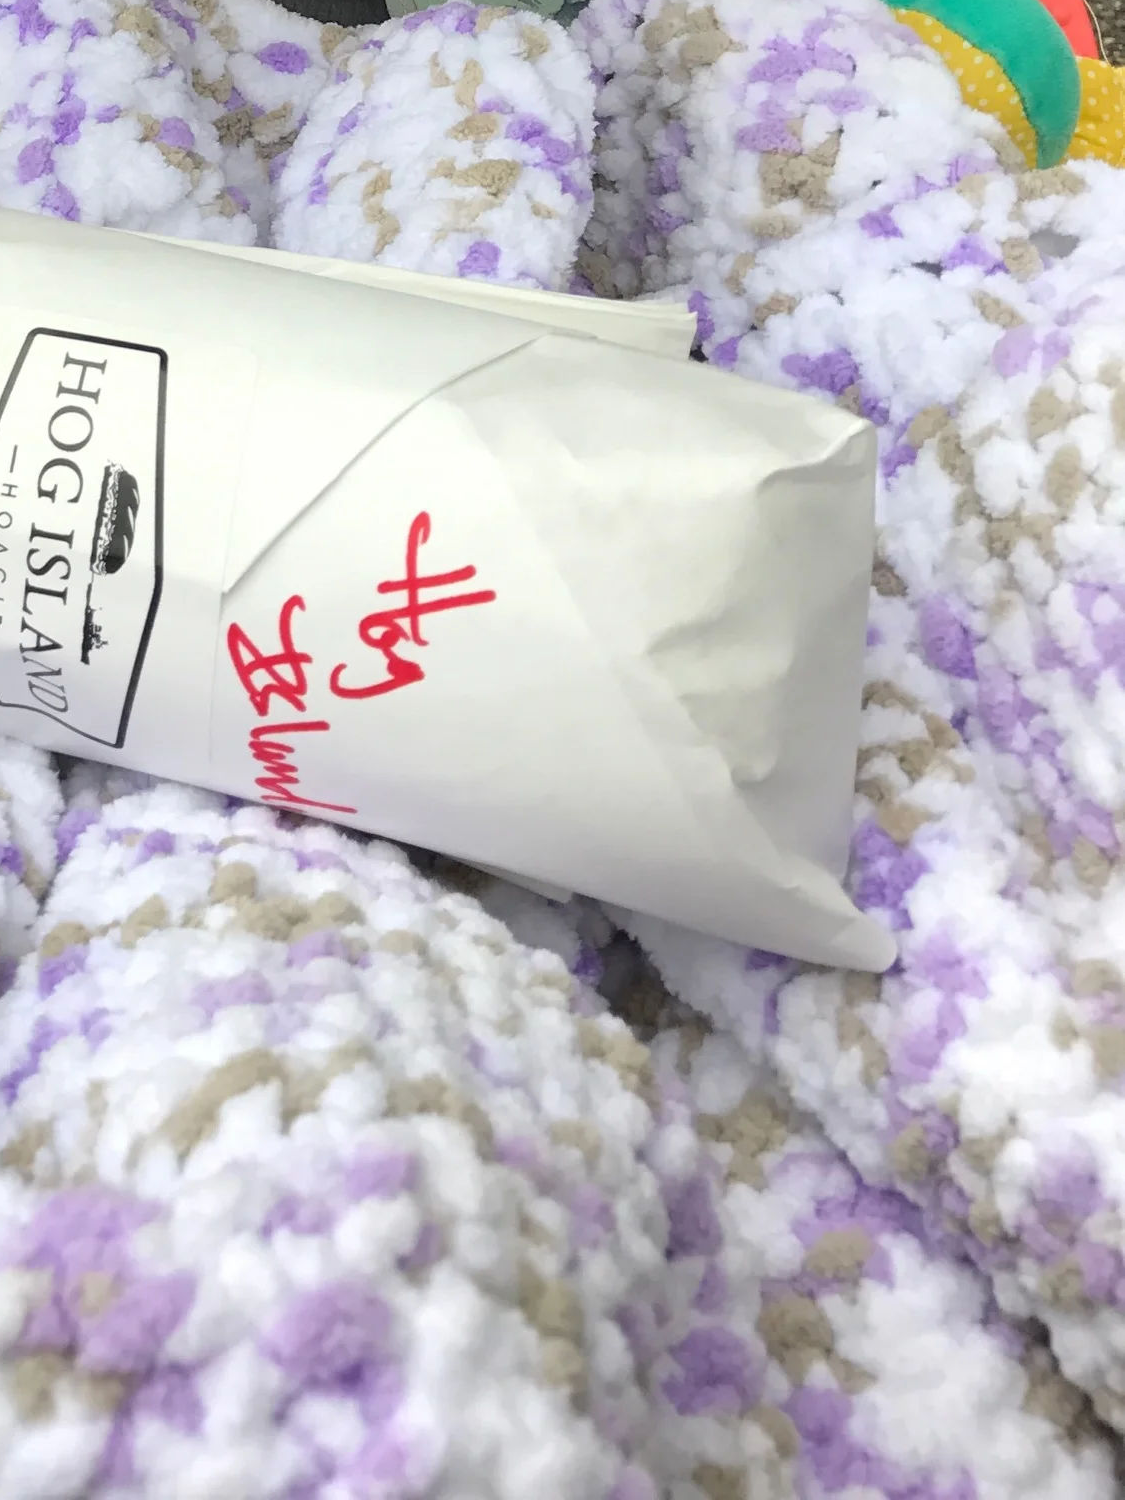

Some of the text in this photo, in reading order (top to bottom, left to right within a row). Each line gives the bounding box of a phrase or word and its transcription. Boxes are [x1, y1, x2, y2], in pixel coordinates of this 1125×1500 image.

[20, 352, 108, 713] HOG ISLAND
[330, 511, 495, 698] Hog
